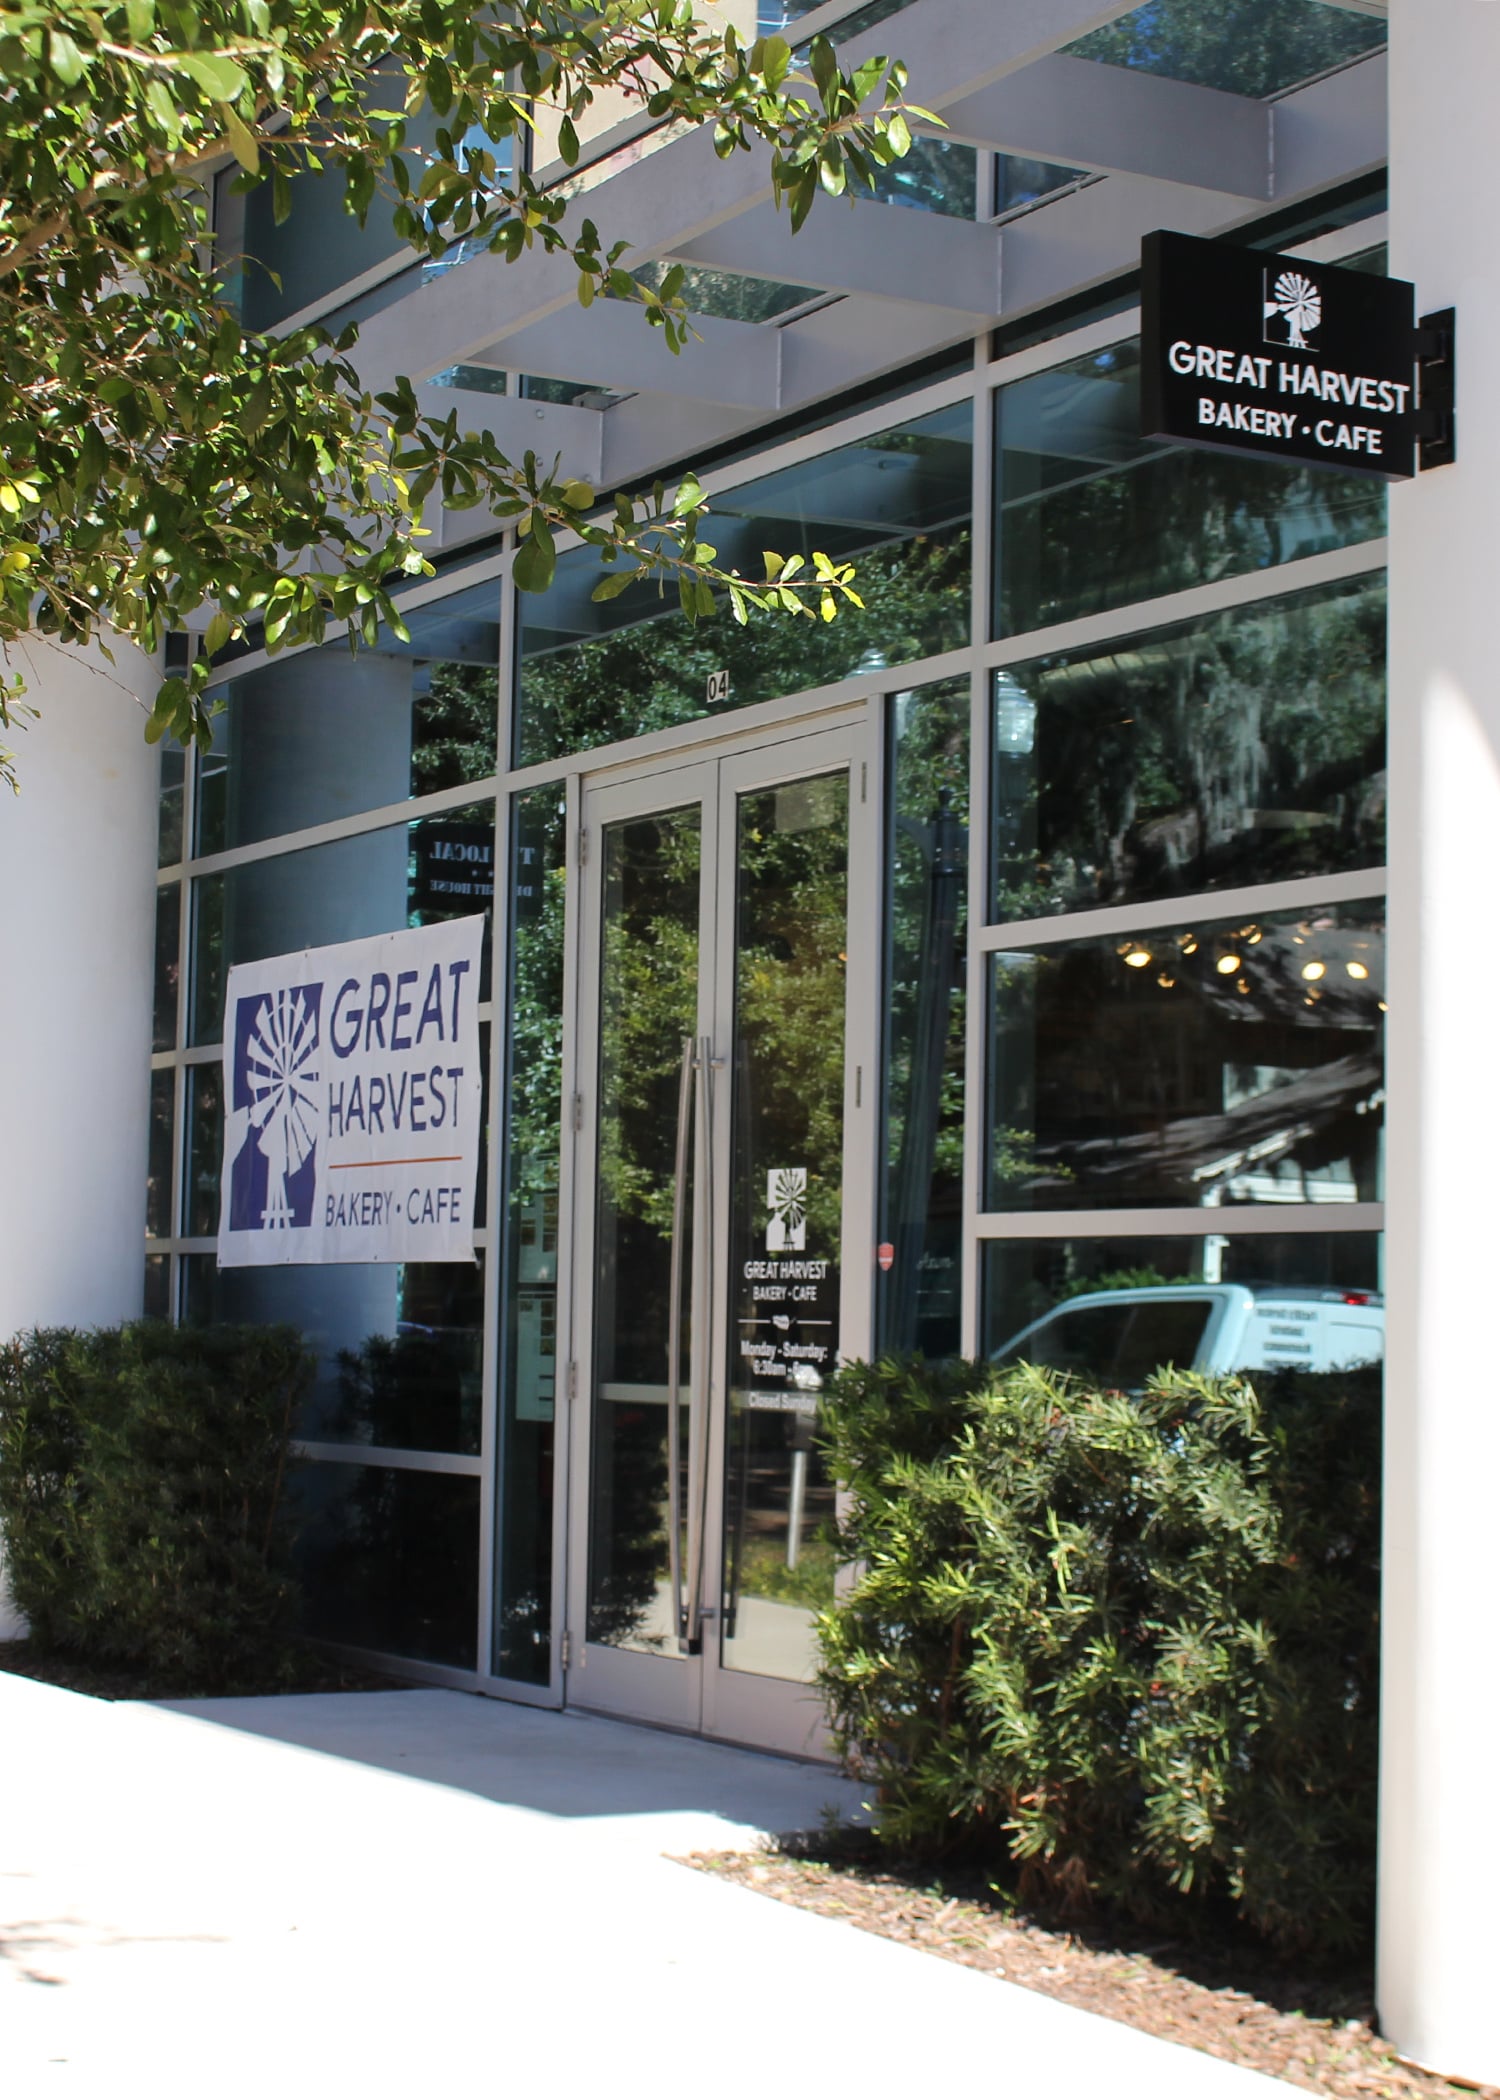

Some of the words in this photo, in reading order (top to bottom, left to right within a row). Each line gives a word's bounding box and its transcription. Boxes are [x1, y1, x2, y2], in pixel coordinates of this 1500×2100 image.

[1168, 341, 1272, 389] GREAT
[1278, 361, 1410, 414] HARVEST
[1198, 398, 1298, 439] BAKERY
[1315, 419, 1383, 454] CAFE
[708, 671, 727, 700] 04
[330, 960, 470, 1059] GREAT
[328, 1065, 464, 1138] HARVEST
[325, 1190, 394, 1228] BAKERY
[407, 1187, 462, 1225] CAFE
[743, 1261, 779, 1279] GREAT
[780, 1260, 829, 1280] HARVEST
[752, 1286, 787, 1301] BAKERY
[792, 1286, 818, 1301] CAFE
[740, 1340, 777, 1360] Monday
